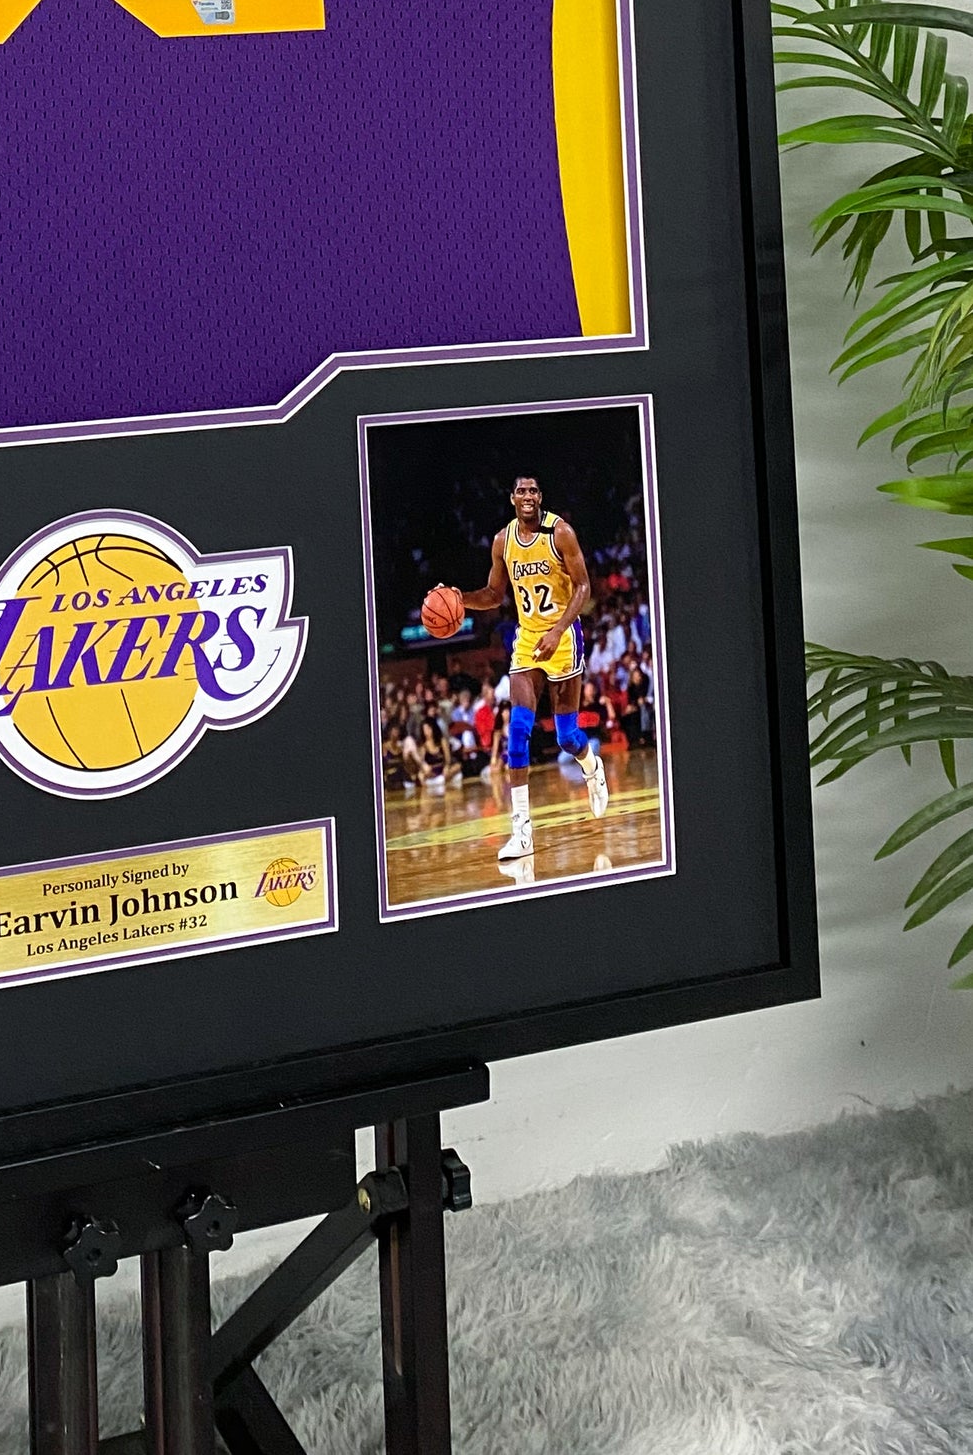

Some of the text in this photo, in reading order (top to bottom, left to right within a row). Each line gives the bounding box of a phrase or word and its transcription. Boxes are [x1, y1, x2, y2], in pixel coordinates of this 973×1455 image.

[512, 560, 551, 581] LAKERS
[50, 574, 269, 613] LOS ANGELES
[518, 584, 558, 618] 32
[42, 862, 190, 896] Personally Signed by
[253, 870, 317, 898] LAKERS
[109, 881, 239, 926] Johnson
[26, 914, 208, 957] Los Angeles Lakers #32
